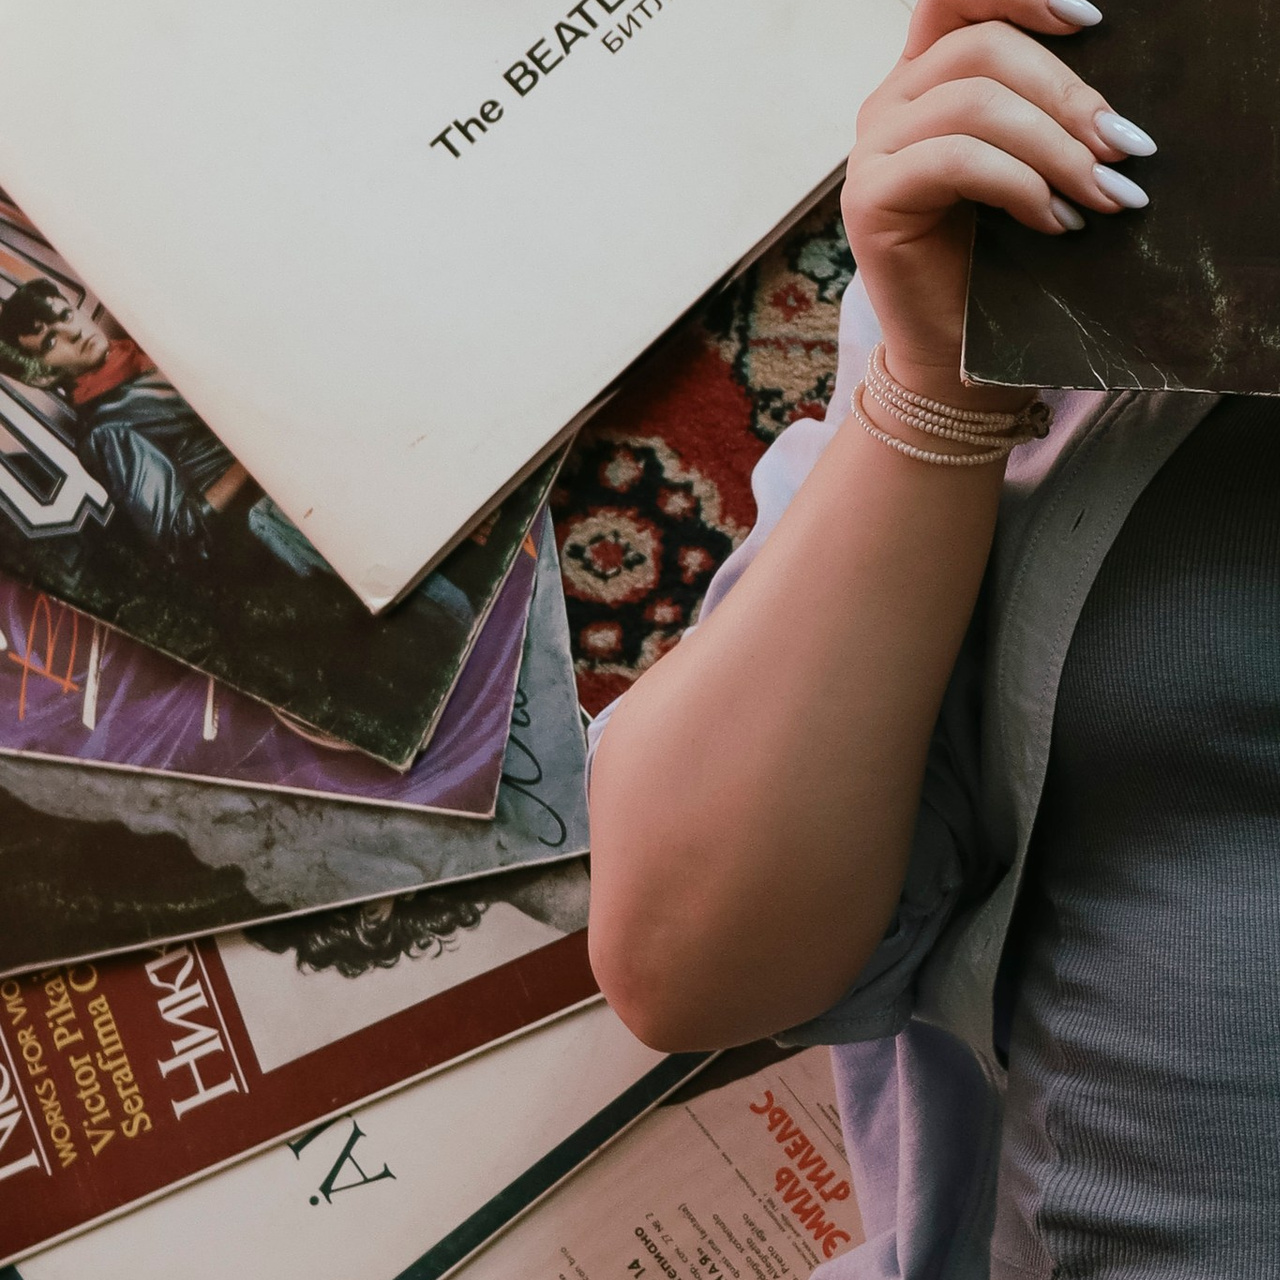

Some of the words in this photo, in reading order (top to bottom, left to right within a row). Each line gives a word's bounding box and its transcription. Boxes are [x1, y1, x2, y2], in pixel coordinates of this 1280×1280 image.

[429, 99, 504, 159] The
[18, 1025, 48, 1076] FOR
[88, 994, 152, 1139] Serafima
[69, 1053, 115, 1156] Victor
[35, 1078, 77, 1167] WORKS
[644, 1211, 654, 1220] 2
[651, 1219, 664, 1233] №
[741, 1212, 767, 1242] agitato
[775, 1167, 850, 1258] ЭМИЛЬ
[660, 1233, 674, 1245] 27
[707, 1238, 721, 1255] una
[712, 1213, 745, 1253] sostenuto
[559, 1246, 576, 1266] brio
[626, 1258, 646, 1279] 14
[718, 1255, 740, 1279] quasi
[745, 1237, 780, 1279] Allegretto
[767, 1245, 790, 1274] Presto
